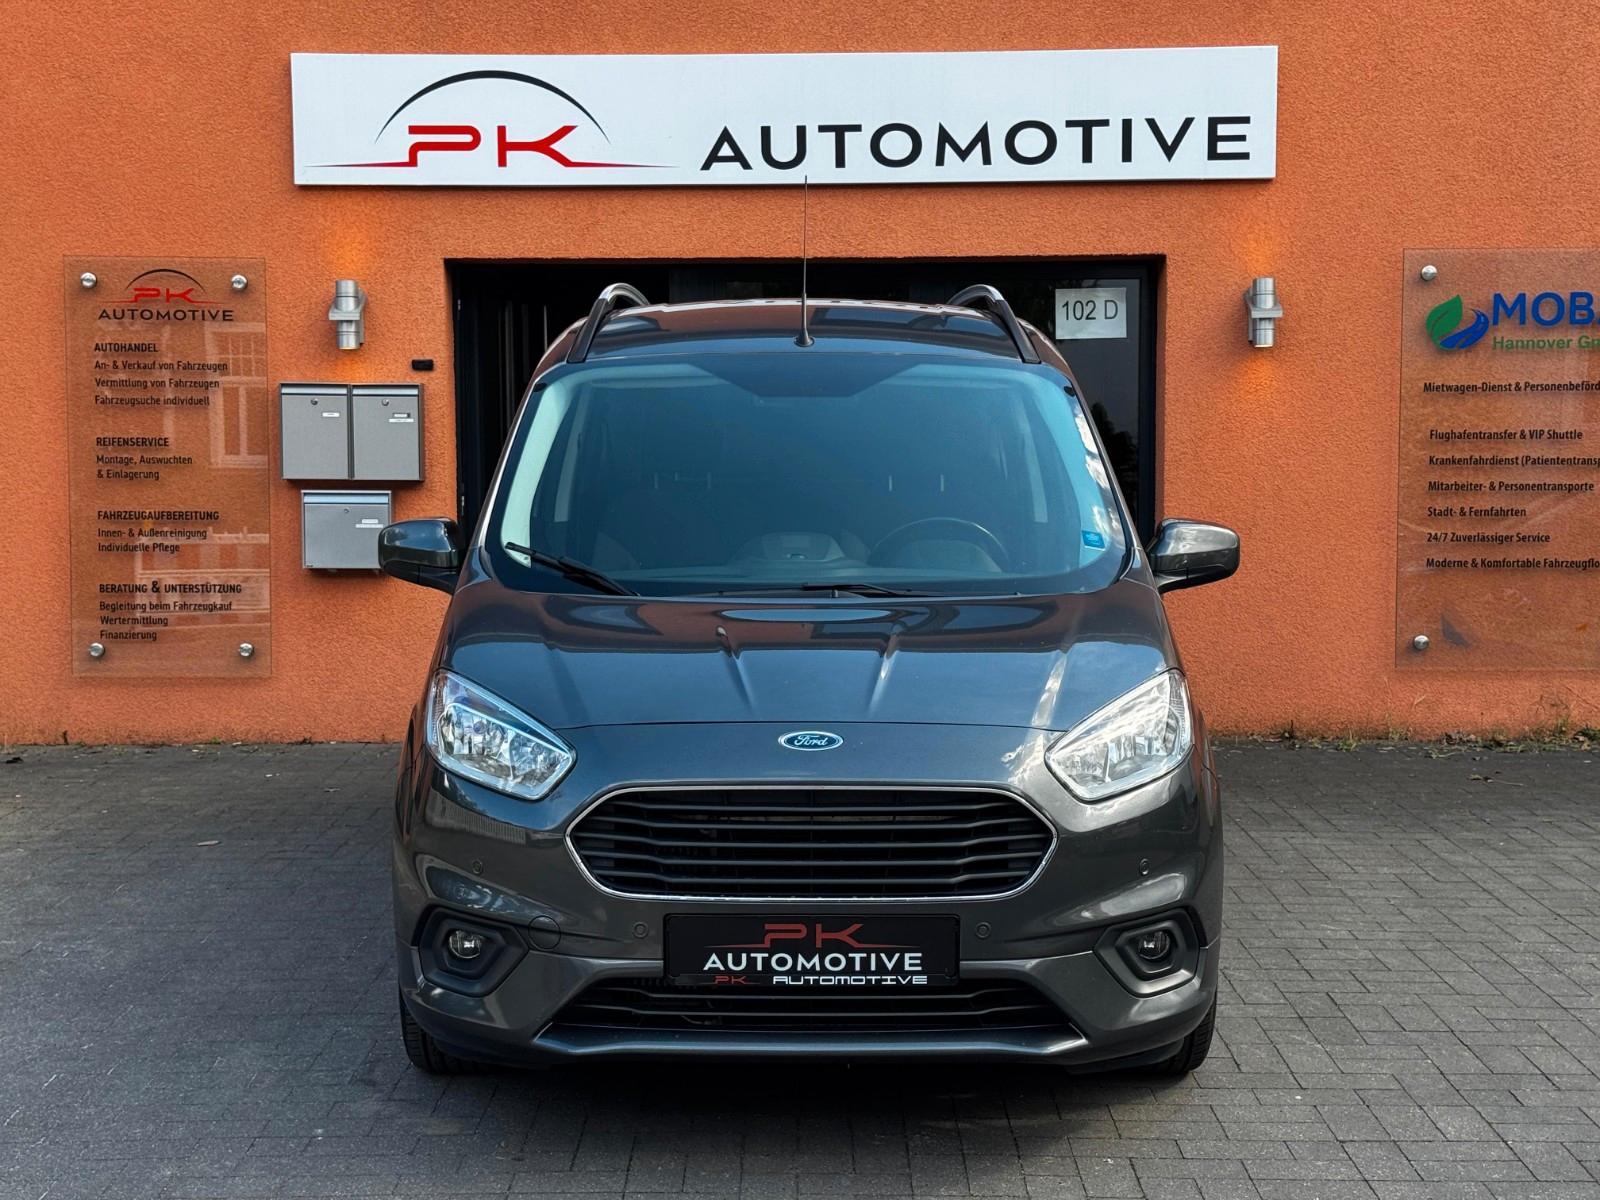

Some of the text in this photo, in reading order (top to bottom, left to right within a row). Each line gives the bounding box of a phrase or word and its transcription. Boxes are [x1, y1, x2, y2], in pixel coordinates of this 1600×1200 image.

[407, 116, 1252, 171] PK AUTOMOTIVE
[131, 287, 195, 303] PK
[98, 308, 234, 321] AUTOMOTIVE
[1062, 300, 1119, 321] 102 D
[1491, 291, 1600, 327] MOB
[94, 342, 159, 353] AUTOHANDEL
[1492, 336, 1573, 350] Hannover
[94, 360, 228, 373] An- & Verkauf von Fahrzeugen
[95, 378, 220, 390] Vermittlung von Fahrzeugen
[1423, 382, 1512, 394] Mietwagen-Dienst
[1514, 382, 1522, 392] &
[95, 395, 210, 407] Fahrzeugsuche individuell
[1429, 429, 1583, 442] Flughafentransfer & VIP Shuttle
[96, 437, 170, 447] REIFENSERVICE
[96, 455, 193, 466] Montage, Auswuchten
[1429, 455, 1519, 466] Krankenfahrdienst
[97, 470, 160, 481] & Einlagerung
[1428, 481, 1595, 493] Mitarbeiter- & Personentransporte
[97, 511, 220, 521] FAHRZEUGAUFBEREITUNG
[1427, 506, 1527, 517] Stadt- & Fernfahrten
[98, 528, 208, 539] Innen- & Außenreinigung
[1426, 532, 1551, 545] 24/7 Zuverlässiger Service
[98, 542, 181, 554] Individuelle Pflege
[1426, 558, 1469, 568] Moderne
[1471, 558, 1479, 568] &
[1480, 558, 1541, 568] Komfortable
[99, 580, 242, 594] BERATUNG & UNTERSTÜTZUNG
[99, 601, 232, 613] Begleitung beim Fahrzeugkauf
[100, 615, 169, 627] Wertermittlung
[100, 630, 158, 642] Finanzierung
[794, 735, 829, 746] Ford
[763, 923, 865, 948] PK
[703, 952, 922, 972] AUTOMOTIVE
[772, 975, 928, 985] AUTOMOTIVE
